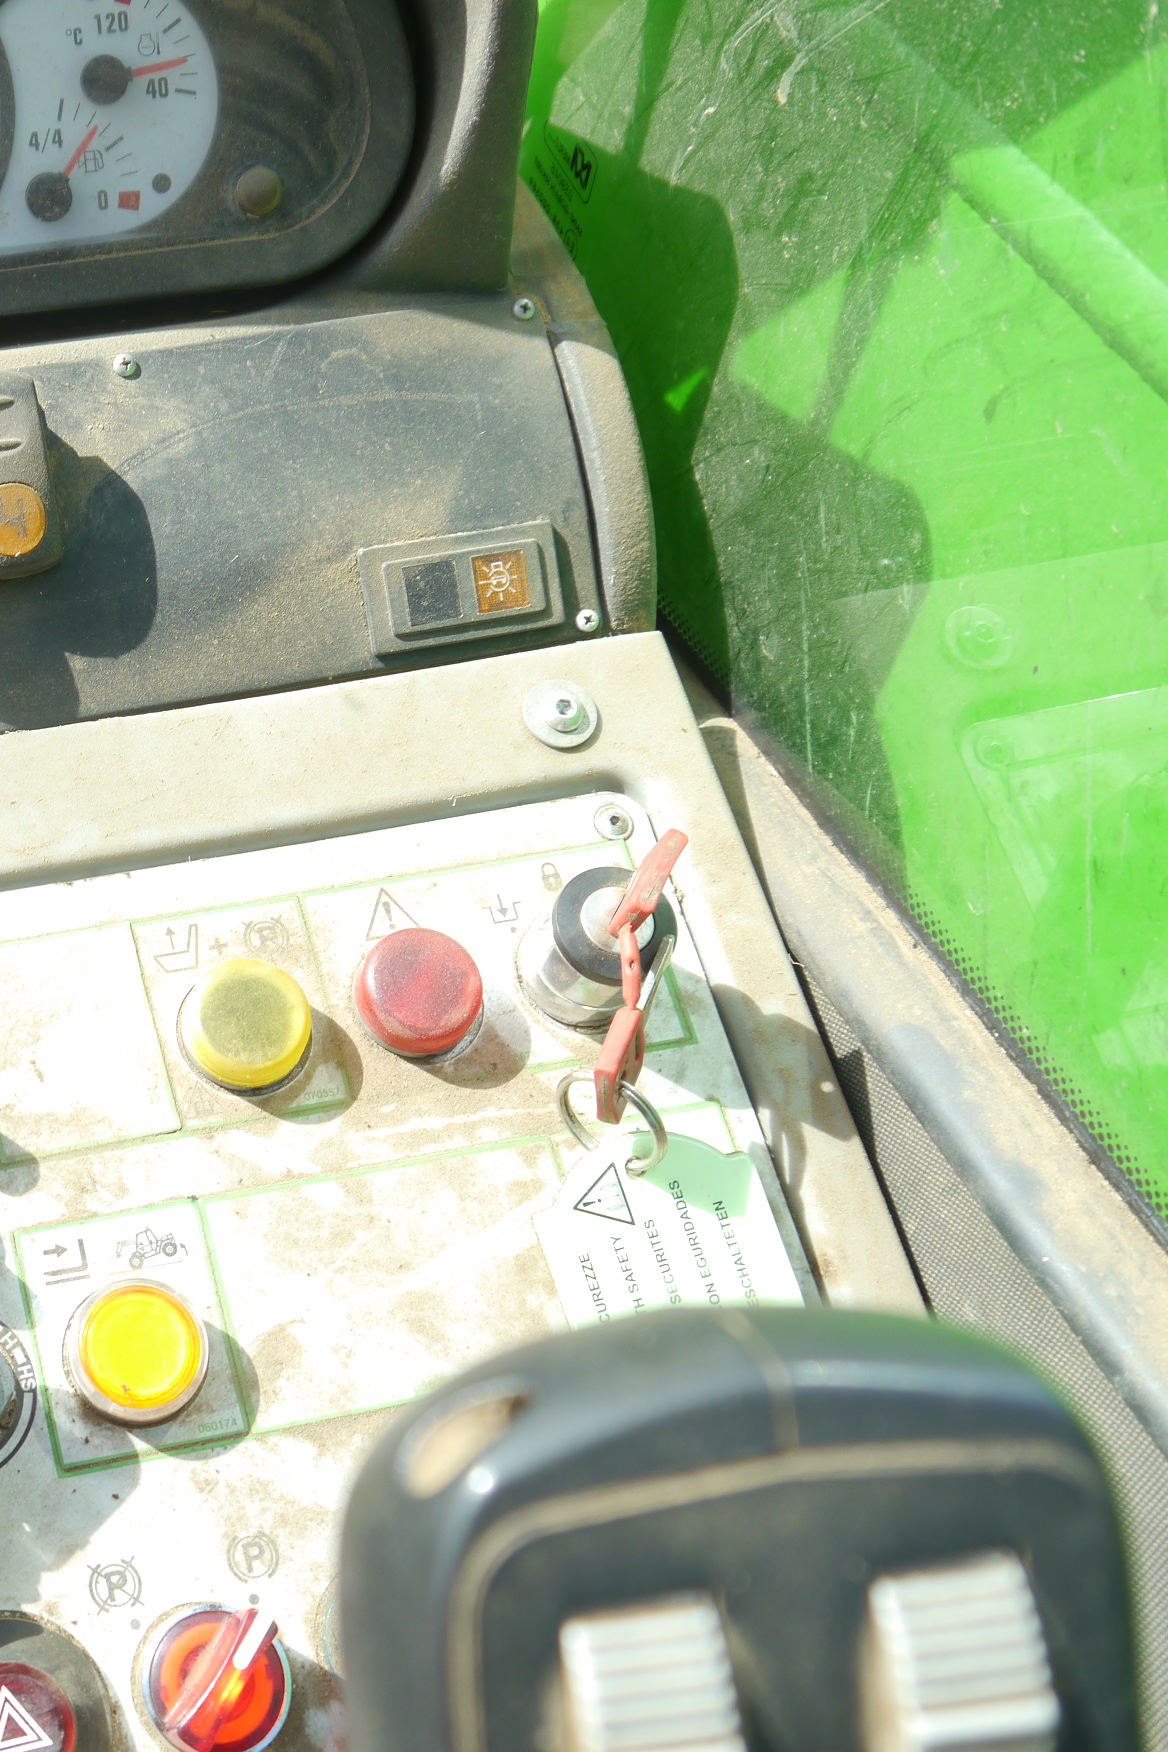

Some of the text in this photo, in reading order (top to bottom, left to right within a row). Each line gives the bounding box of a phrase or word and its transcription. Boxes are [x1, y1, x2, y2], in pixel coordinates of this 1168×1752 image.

[94, 11, 129, 35] 120
[146, 77, 169, 100] 40
[28, 128, 64, 153] 4/4
[97, 190, 109, 210] 0
[668, 1180, 712, 1279] EGURIDADES
[610, 1236, 639, 1294] SAFETY
[644, 1219, 682, 1305] SECURITES
[0, 1332, 19, 1350] H
[17, 1365, 36, 1392] HS
[198, 1417, 238, 1434] 060174
